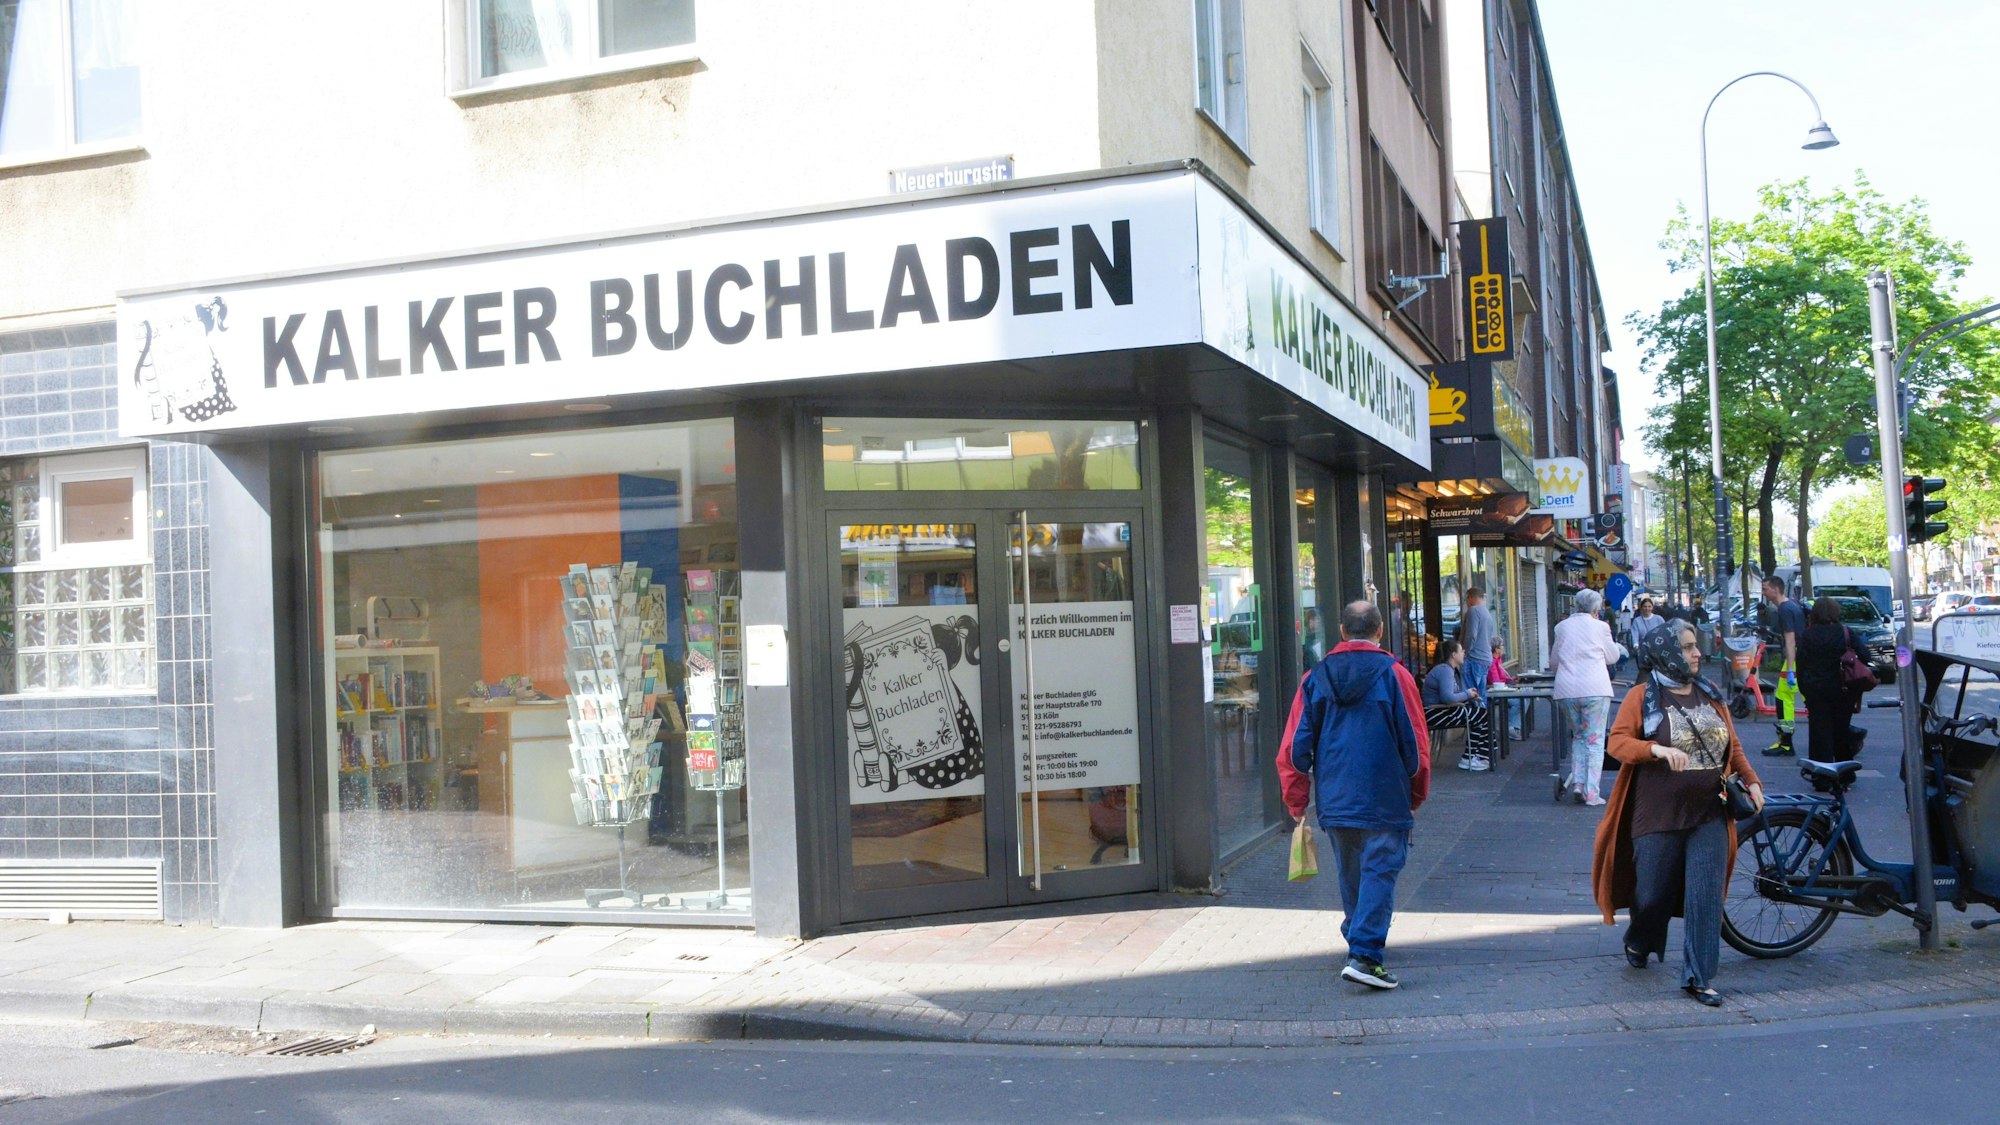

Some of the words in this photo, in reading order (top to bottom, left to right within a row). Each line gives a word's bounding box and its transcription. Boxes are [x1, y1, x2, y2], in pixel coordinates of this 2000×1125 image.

[896, 160, 1007, 192] Neuerburgstr.
[263, 287, 561, 388] KALKER
[590, 219, 1133, 357] BUCHLADEN
[1270, 268, 1344, 393] KALKER
[1347, 334, 1416, 441] BUCHLADEN
[1430, 507, 1483, 518] Schwarzbrot
[1018, 614, 1057, 625] Hrzlich
[1060, 613, 1118, 624] Willkommen
[1120, 612, 1131, 622] im
[1018, 629, 1056, 640] KLKER
[1059, 627, 1115, 638] BUCHLADEN
[883, 672, 923, 695] Kalker
[1046, 690, 1081, 699] Buchladen
[1083, 690, 1097, 699] gUG
[875, 689, 944, 722] Buchladen
[1046, 700, 1089, 710] Hauptstraße
[1043, 711, 1059, 719] Köln
[1034, 721, 1082, 730] 221-95286793
[1040, 728, 1133, 741] info@kalkerbuchlanden.de
[1047, 762, 1066, 770] 10:00
[1067, 761, 1078, 769] bis
[1055, 771, 1066, 779] bis
